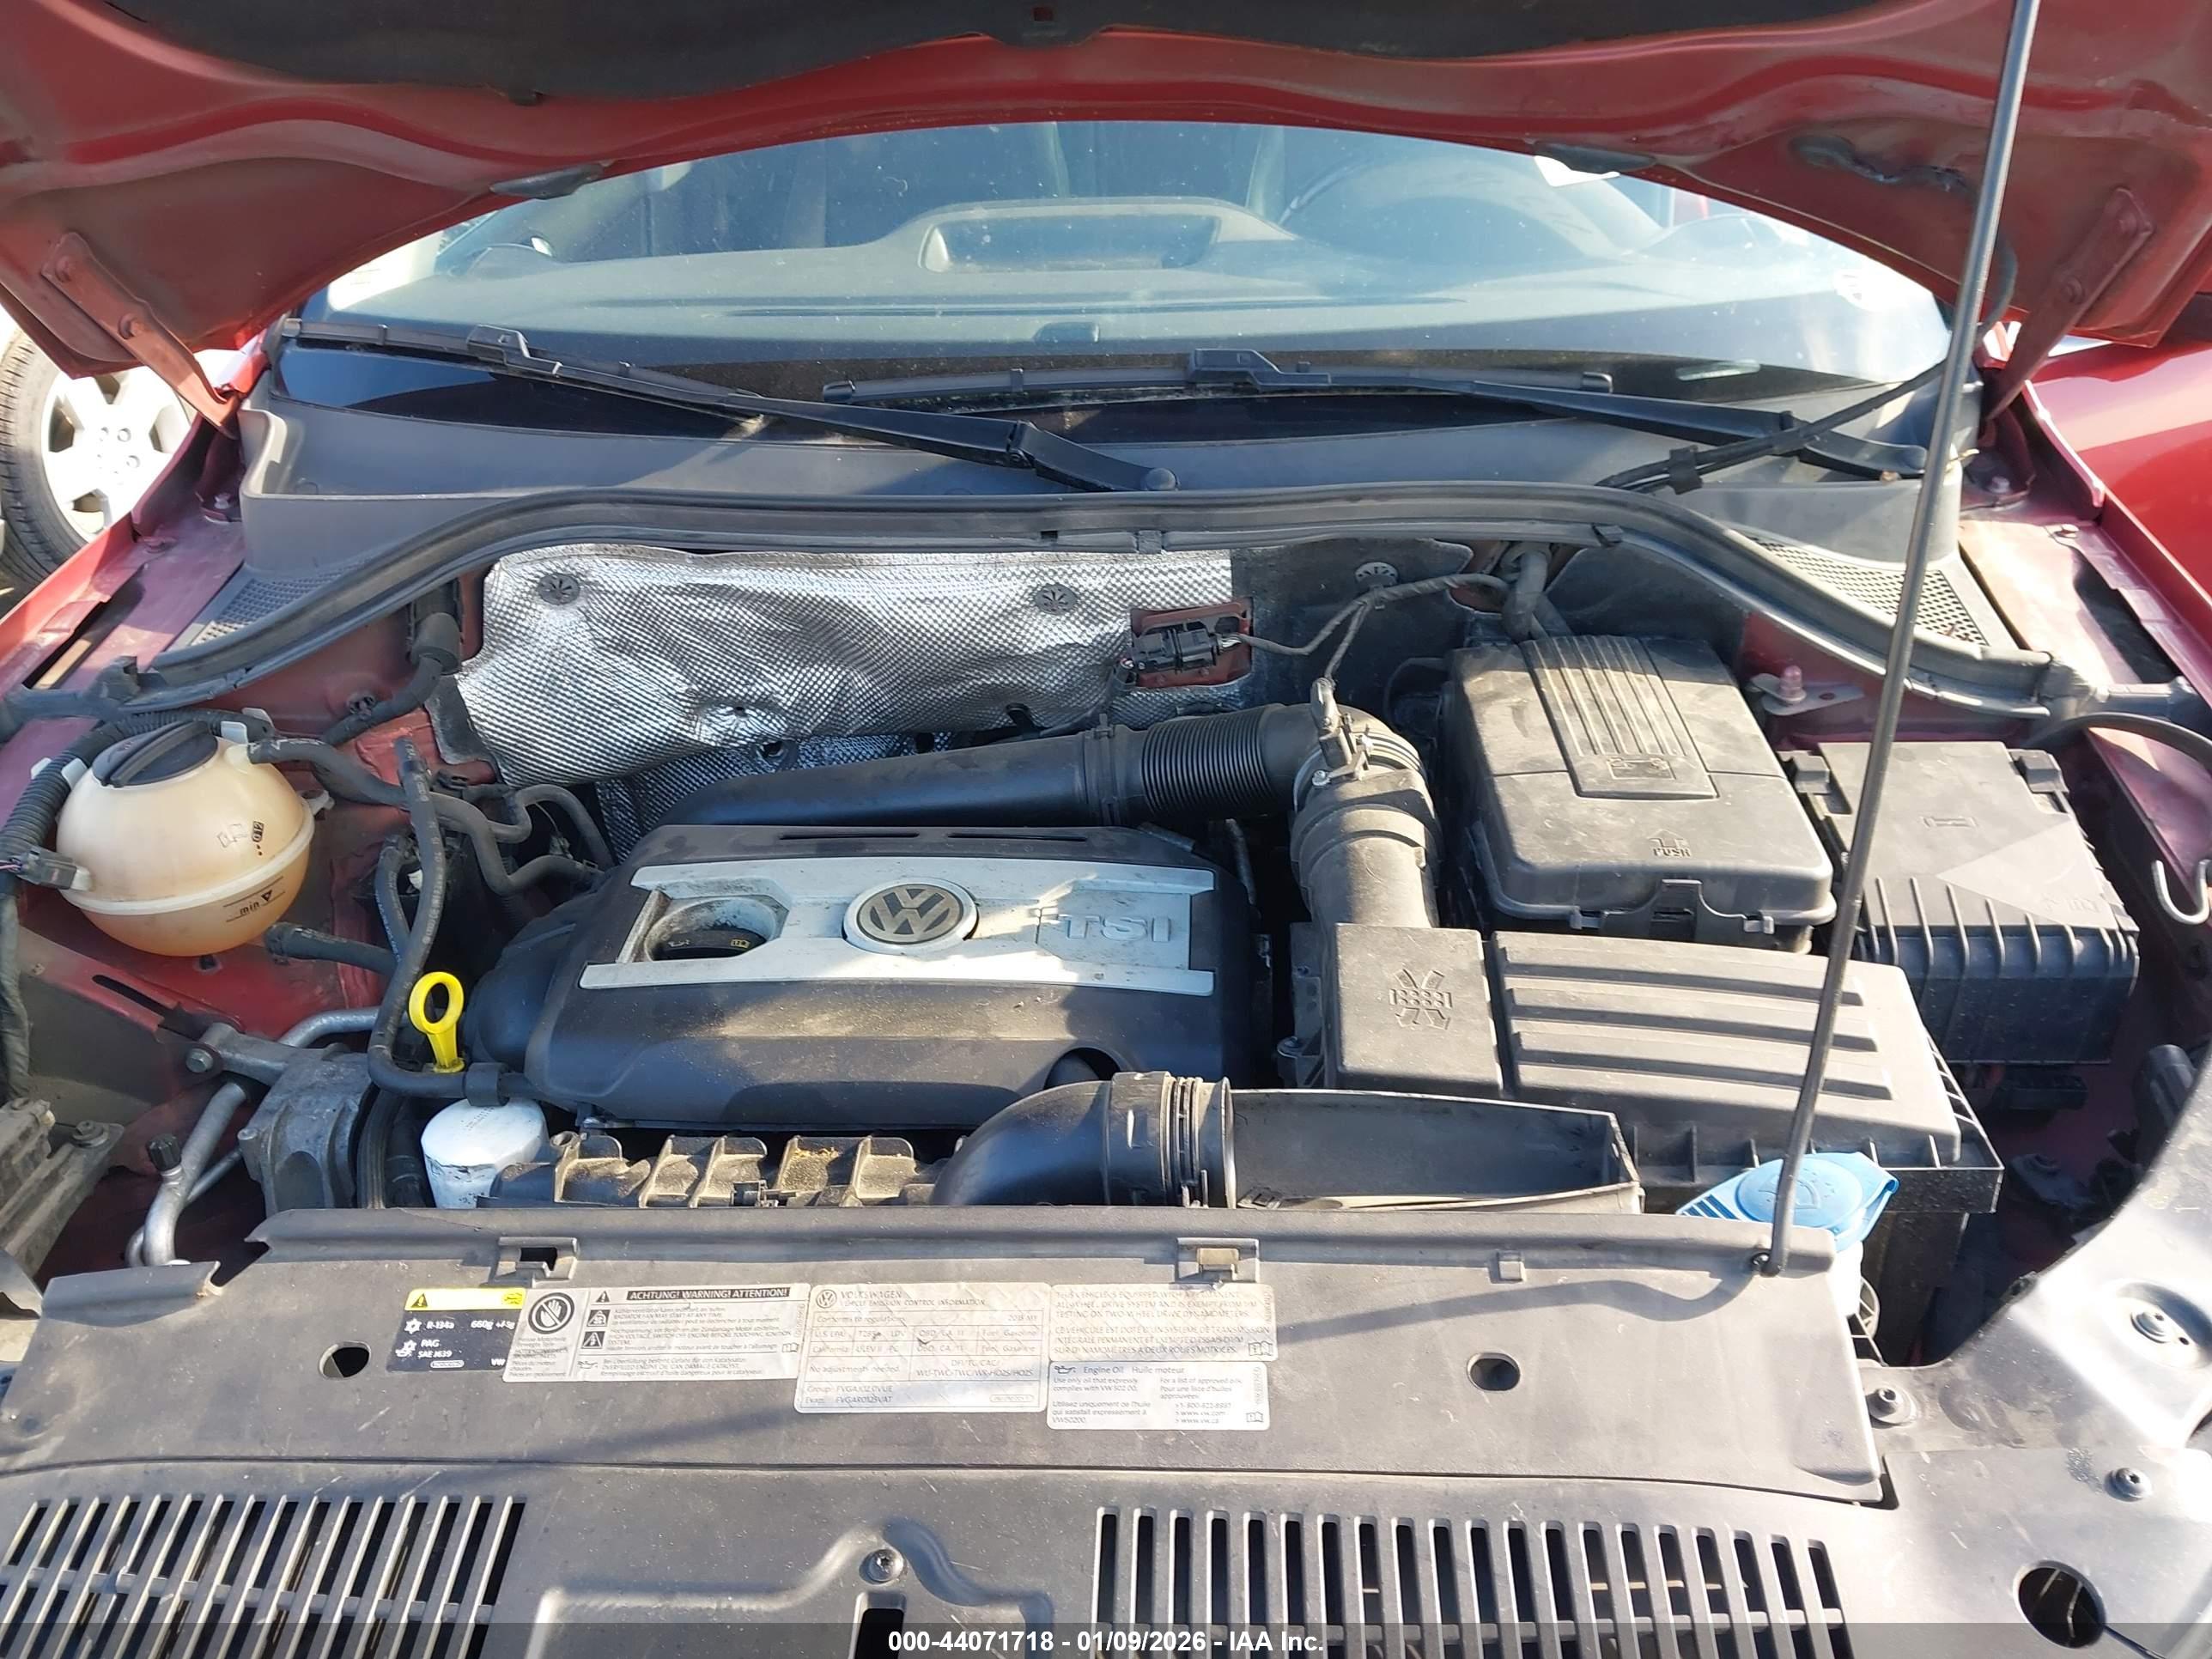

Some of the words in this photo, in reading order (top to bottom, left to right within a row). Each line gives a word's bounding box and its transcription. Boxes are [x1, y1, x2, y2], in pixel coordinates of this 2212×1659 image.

[1653, 848, 1692, 857] PUSH
[240, 901, 260, 915] min
[1061, 914, 1171, 942] TSI
[629, 1291, 679, 1300] ACHTUNG!
[682, 1291, 732, 1299] WARNING!
[732, 1290, 787, 1298] ATTENTION!
[420, 1339, 441, 1347] PAG
[418, 1350, 434, 1358] SAE
